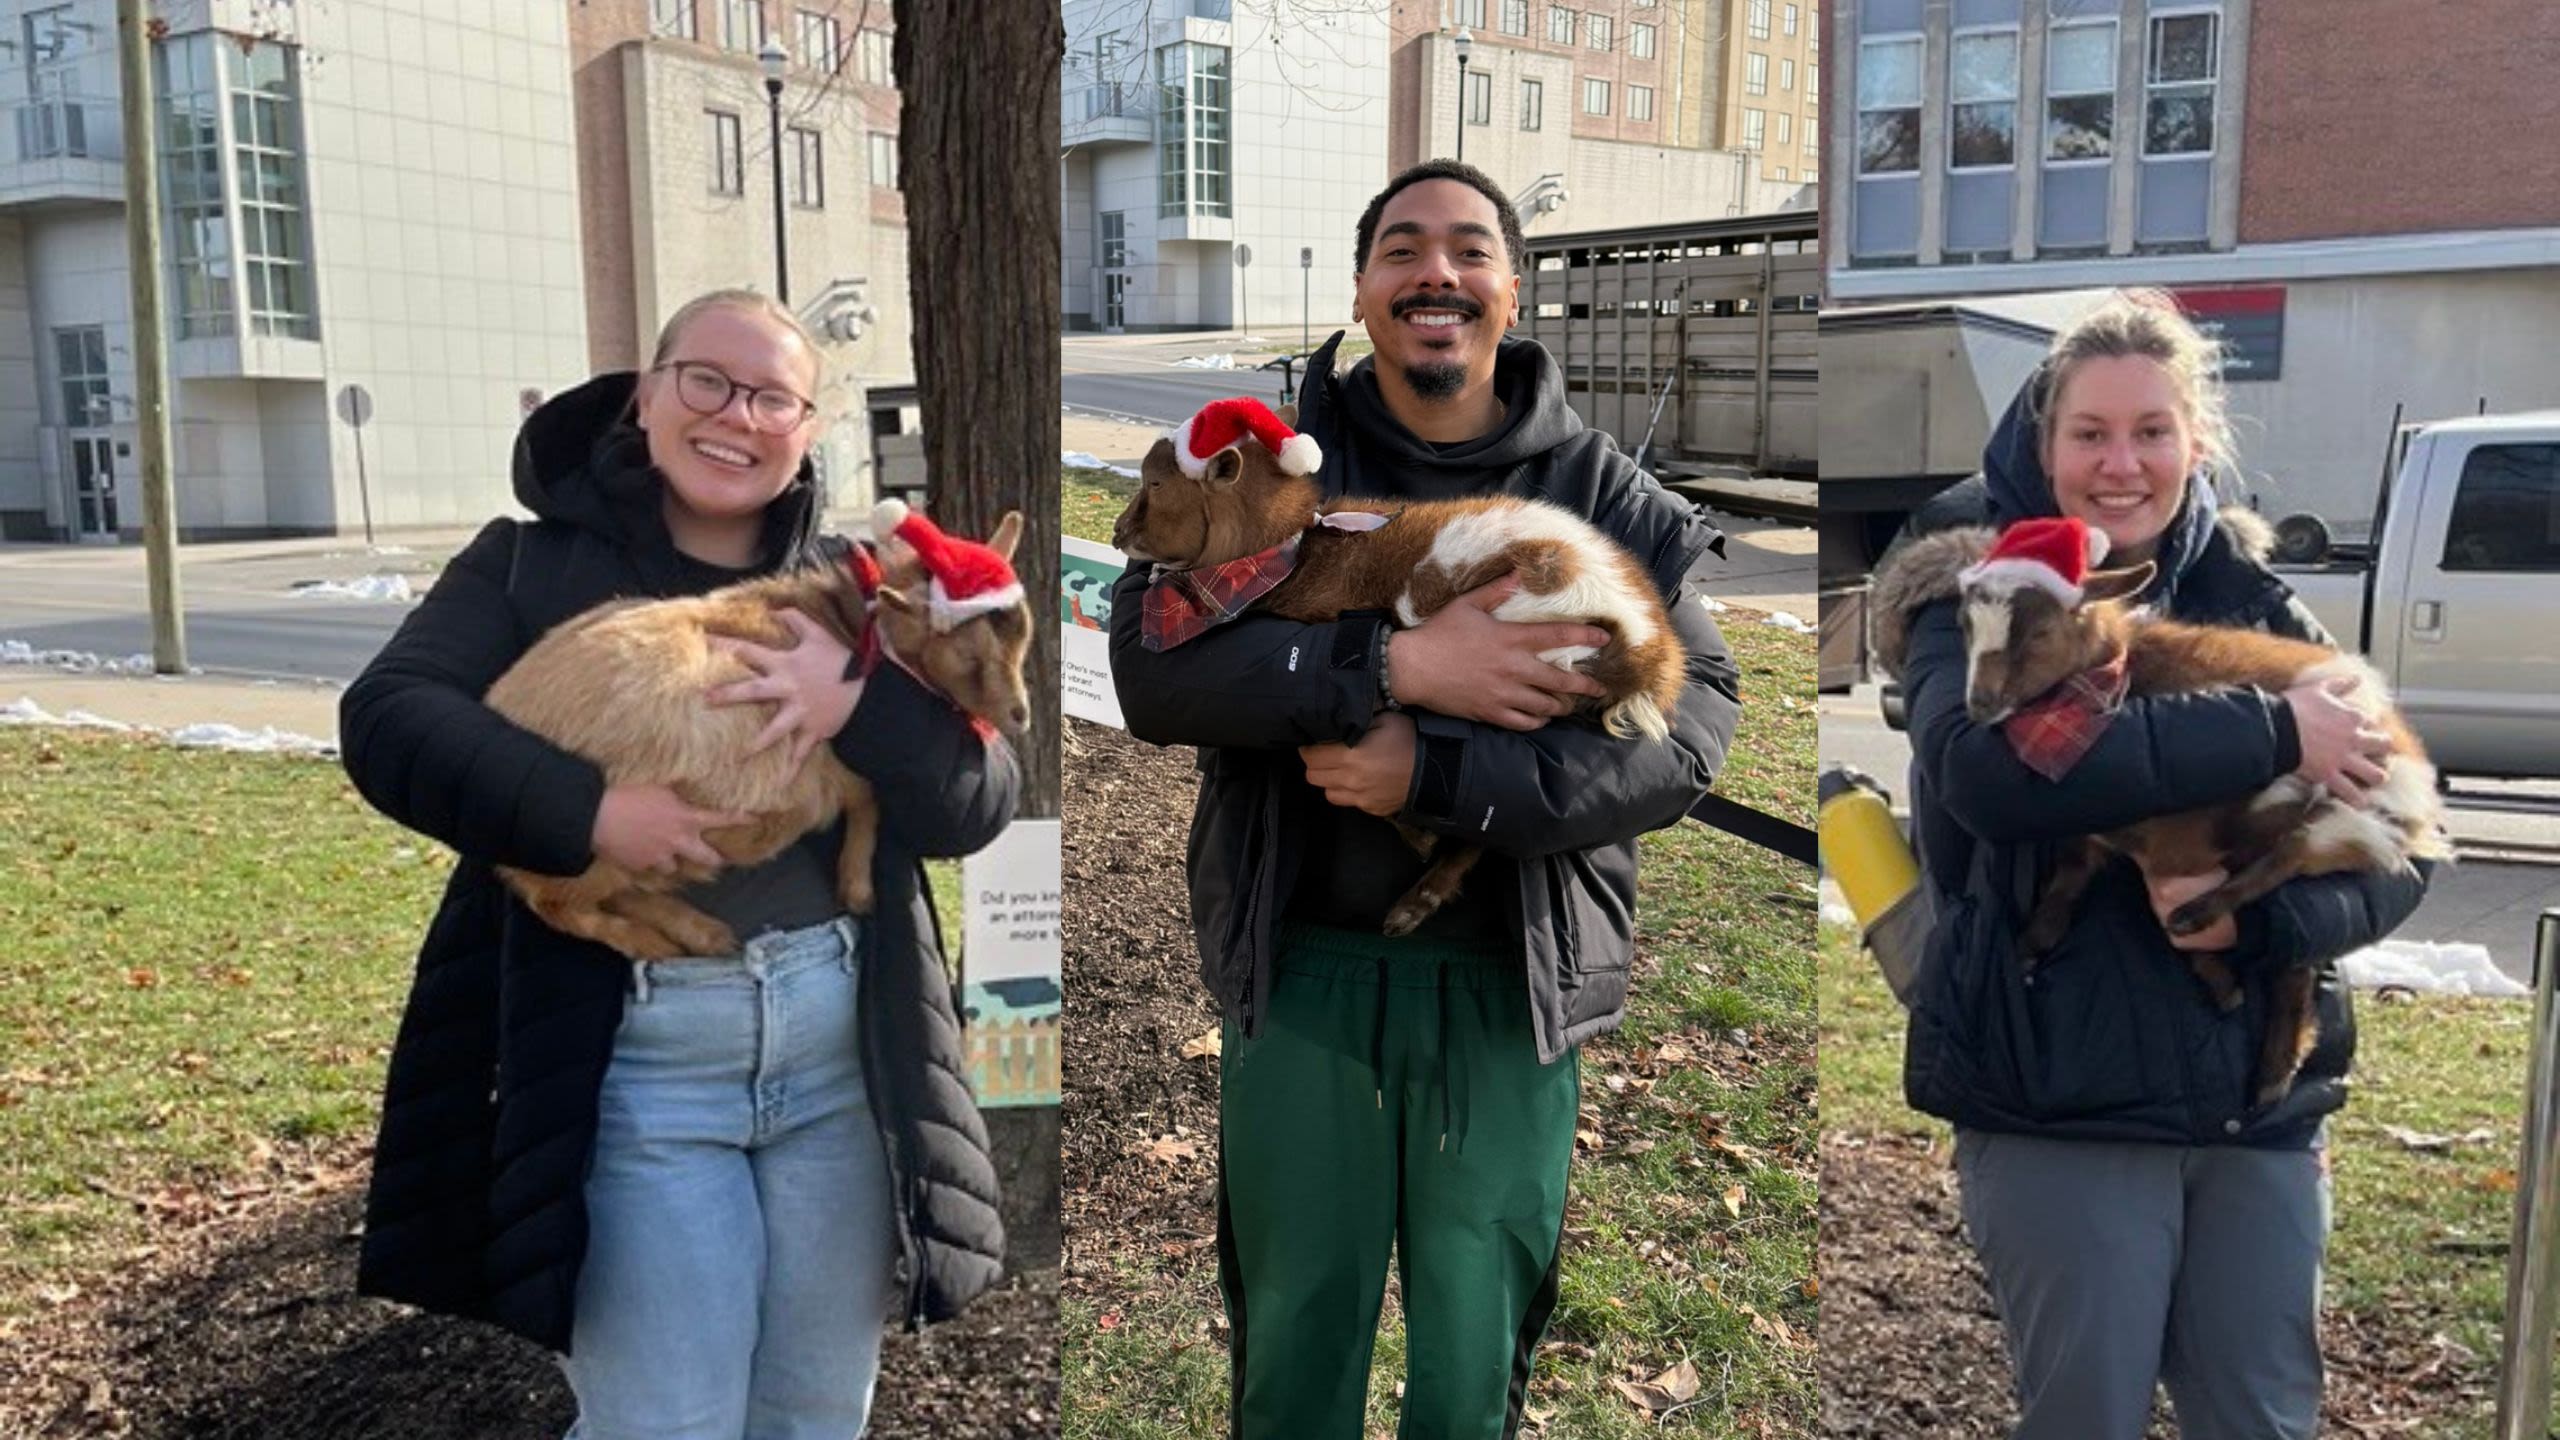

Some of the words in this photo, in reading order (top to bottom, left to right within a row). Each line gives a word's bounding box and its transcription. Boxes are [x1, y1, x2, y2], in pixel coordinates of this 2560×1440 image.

[1067, 662, 1088, 674] Ohio's
[1089, 670, 1108, 680] most
[1067, 675, 1093, 687] vibrant
[981, 890, 1004, 905] Did
[1009, 893, 1037, 907] you
[990, 912, 1007, 923] an
[1009, 930, 1048, 941] more
